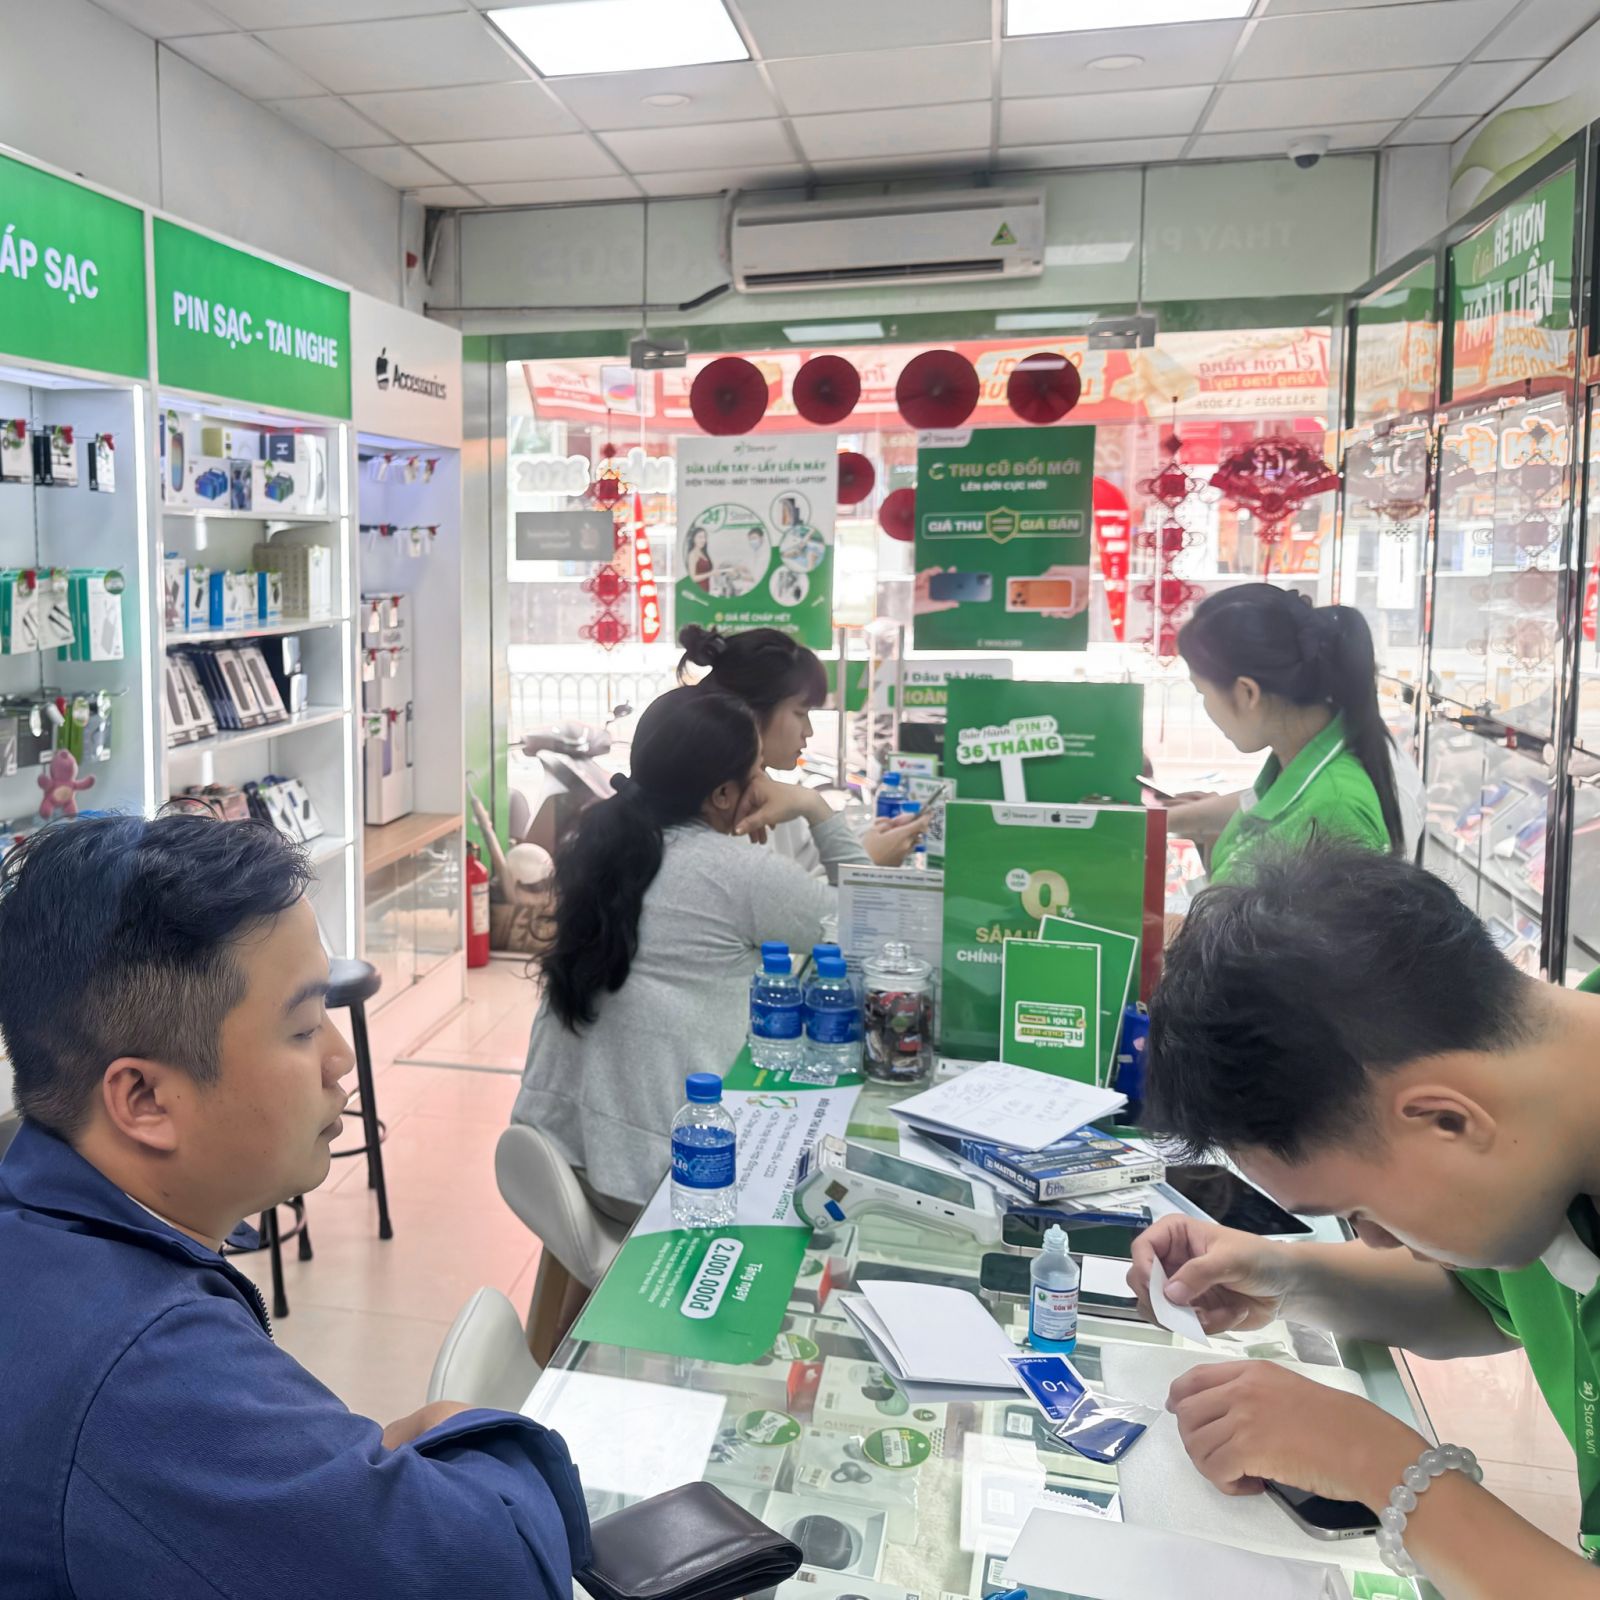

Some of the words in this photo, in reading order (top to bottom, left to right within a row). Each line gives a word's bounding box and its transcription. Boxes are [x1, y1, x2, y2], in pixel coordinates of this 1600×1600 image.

[1512, 199, 1546, 258] HƠN
[44, 247, 99, 304] SẠC
[173, 291, 209, 334] PIN
[213, 304, 252, 350] SẠC
[265, 320, 292, 357] TAI
[295, 331, 338, 369] NGHE
[732, 464, 750, 473] TAY
[803, 460, 827, 471] MÁY
[949, 463, 983, 477] THU
[986, 460, 1010, 477] CŨ
[1047, 459, 1081, 476] MỚI
[928, 519, 953, 532] GIÁ
[954, 520, 983, 532] THU
[1016, 721, 1041, 734] PIN
[961, 745, 984, 760] 36
[987, 735, 1059, 757] THÁNG
[689, 1243, 735, 1312] 2.000.000đ
[1042, 1380, 1070, 1393] 01
